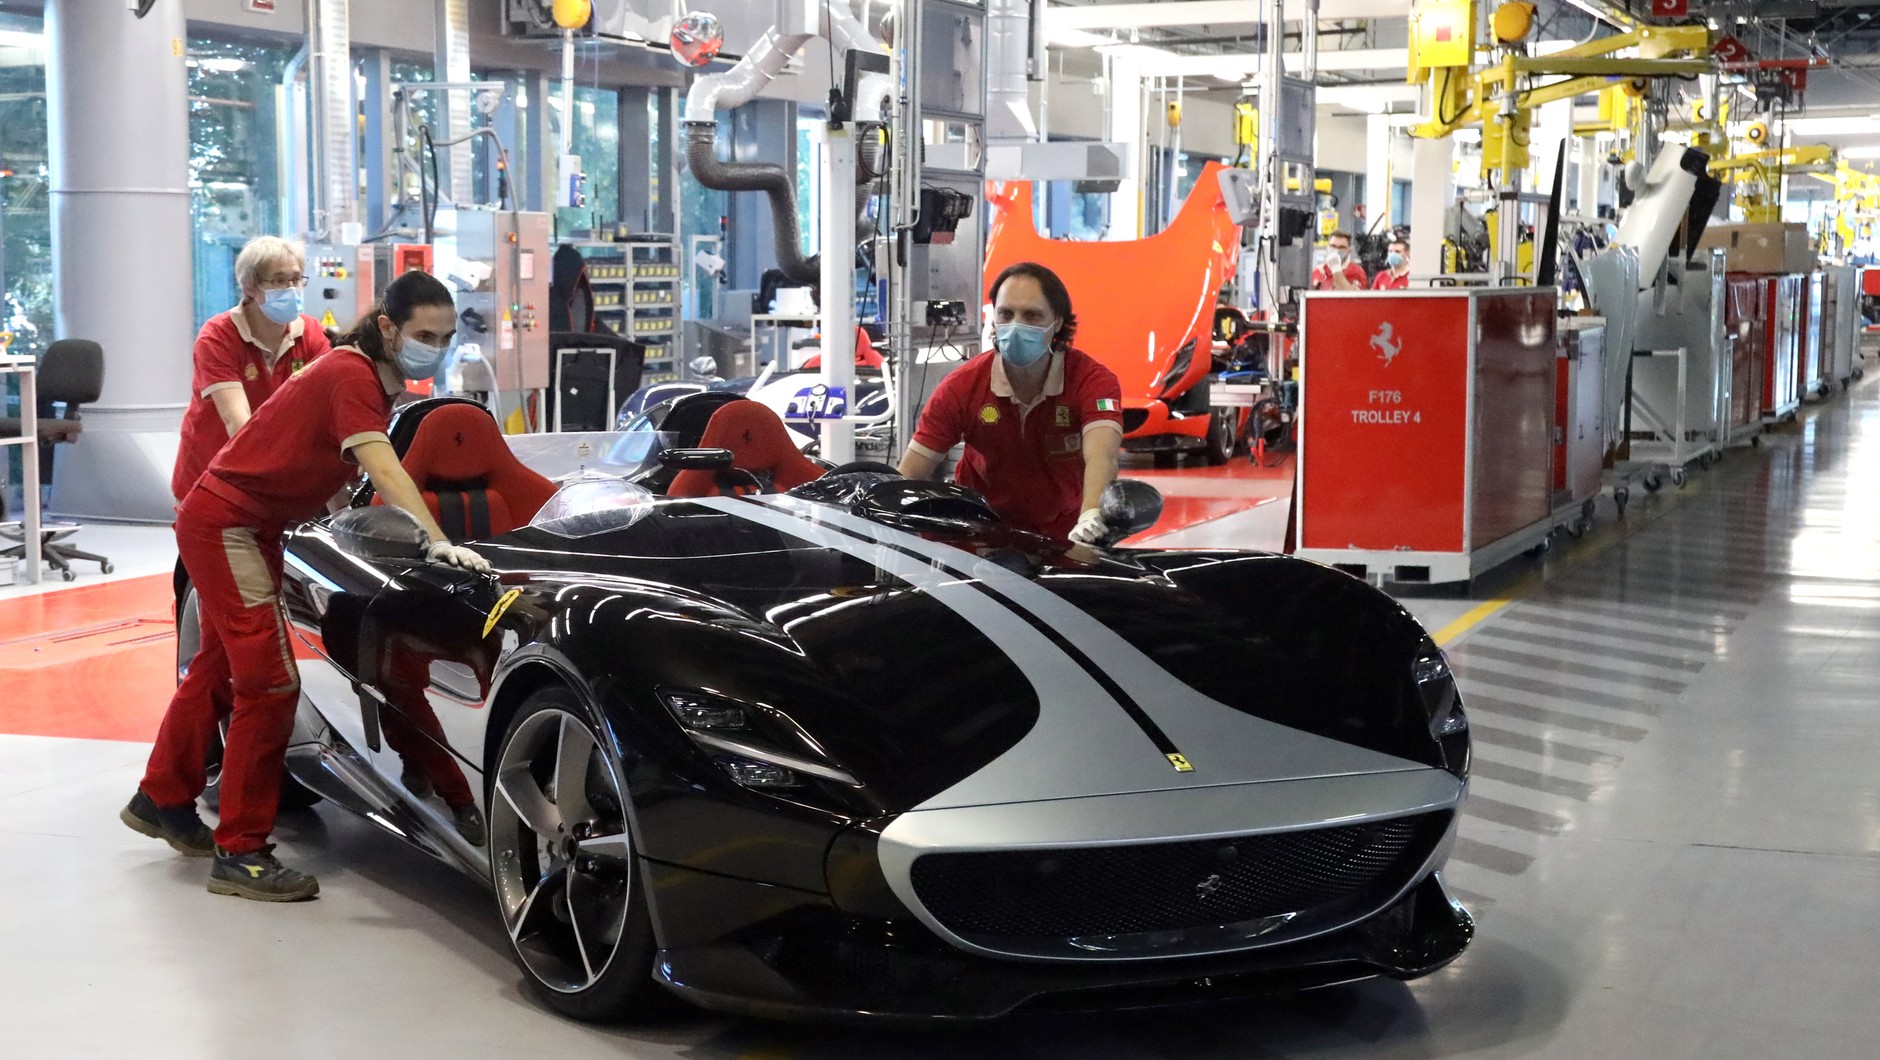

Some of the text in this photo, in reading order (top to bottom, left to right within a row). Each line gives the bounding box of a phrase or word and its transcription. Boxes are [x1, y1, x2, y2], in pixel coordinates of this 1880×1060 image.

[1718, 43, 1736, 61] 2
[1368, 390, 1402, 404] F176
[1351, 410, 1422, 424] TROLLEY 4
